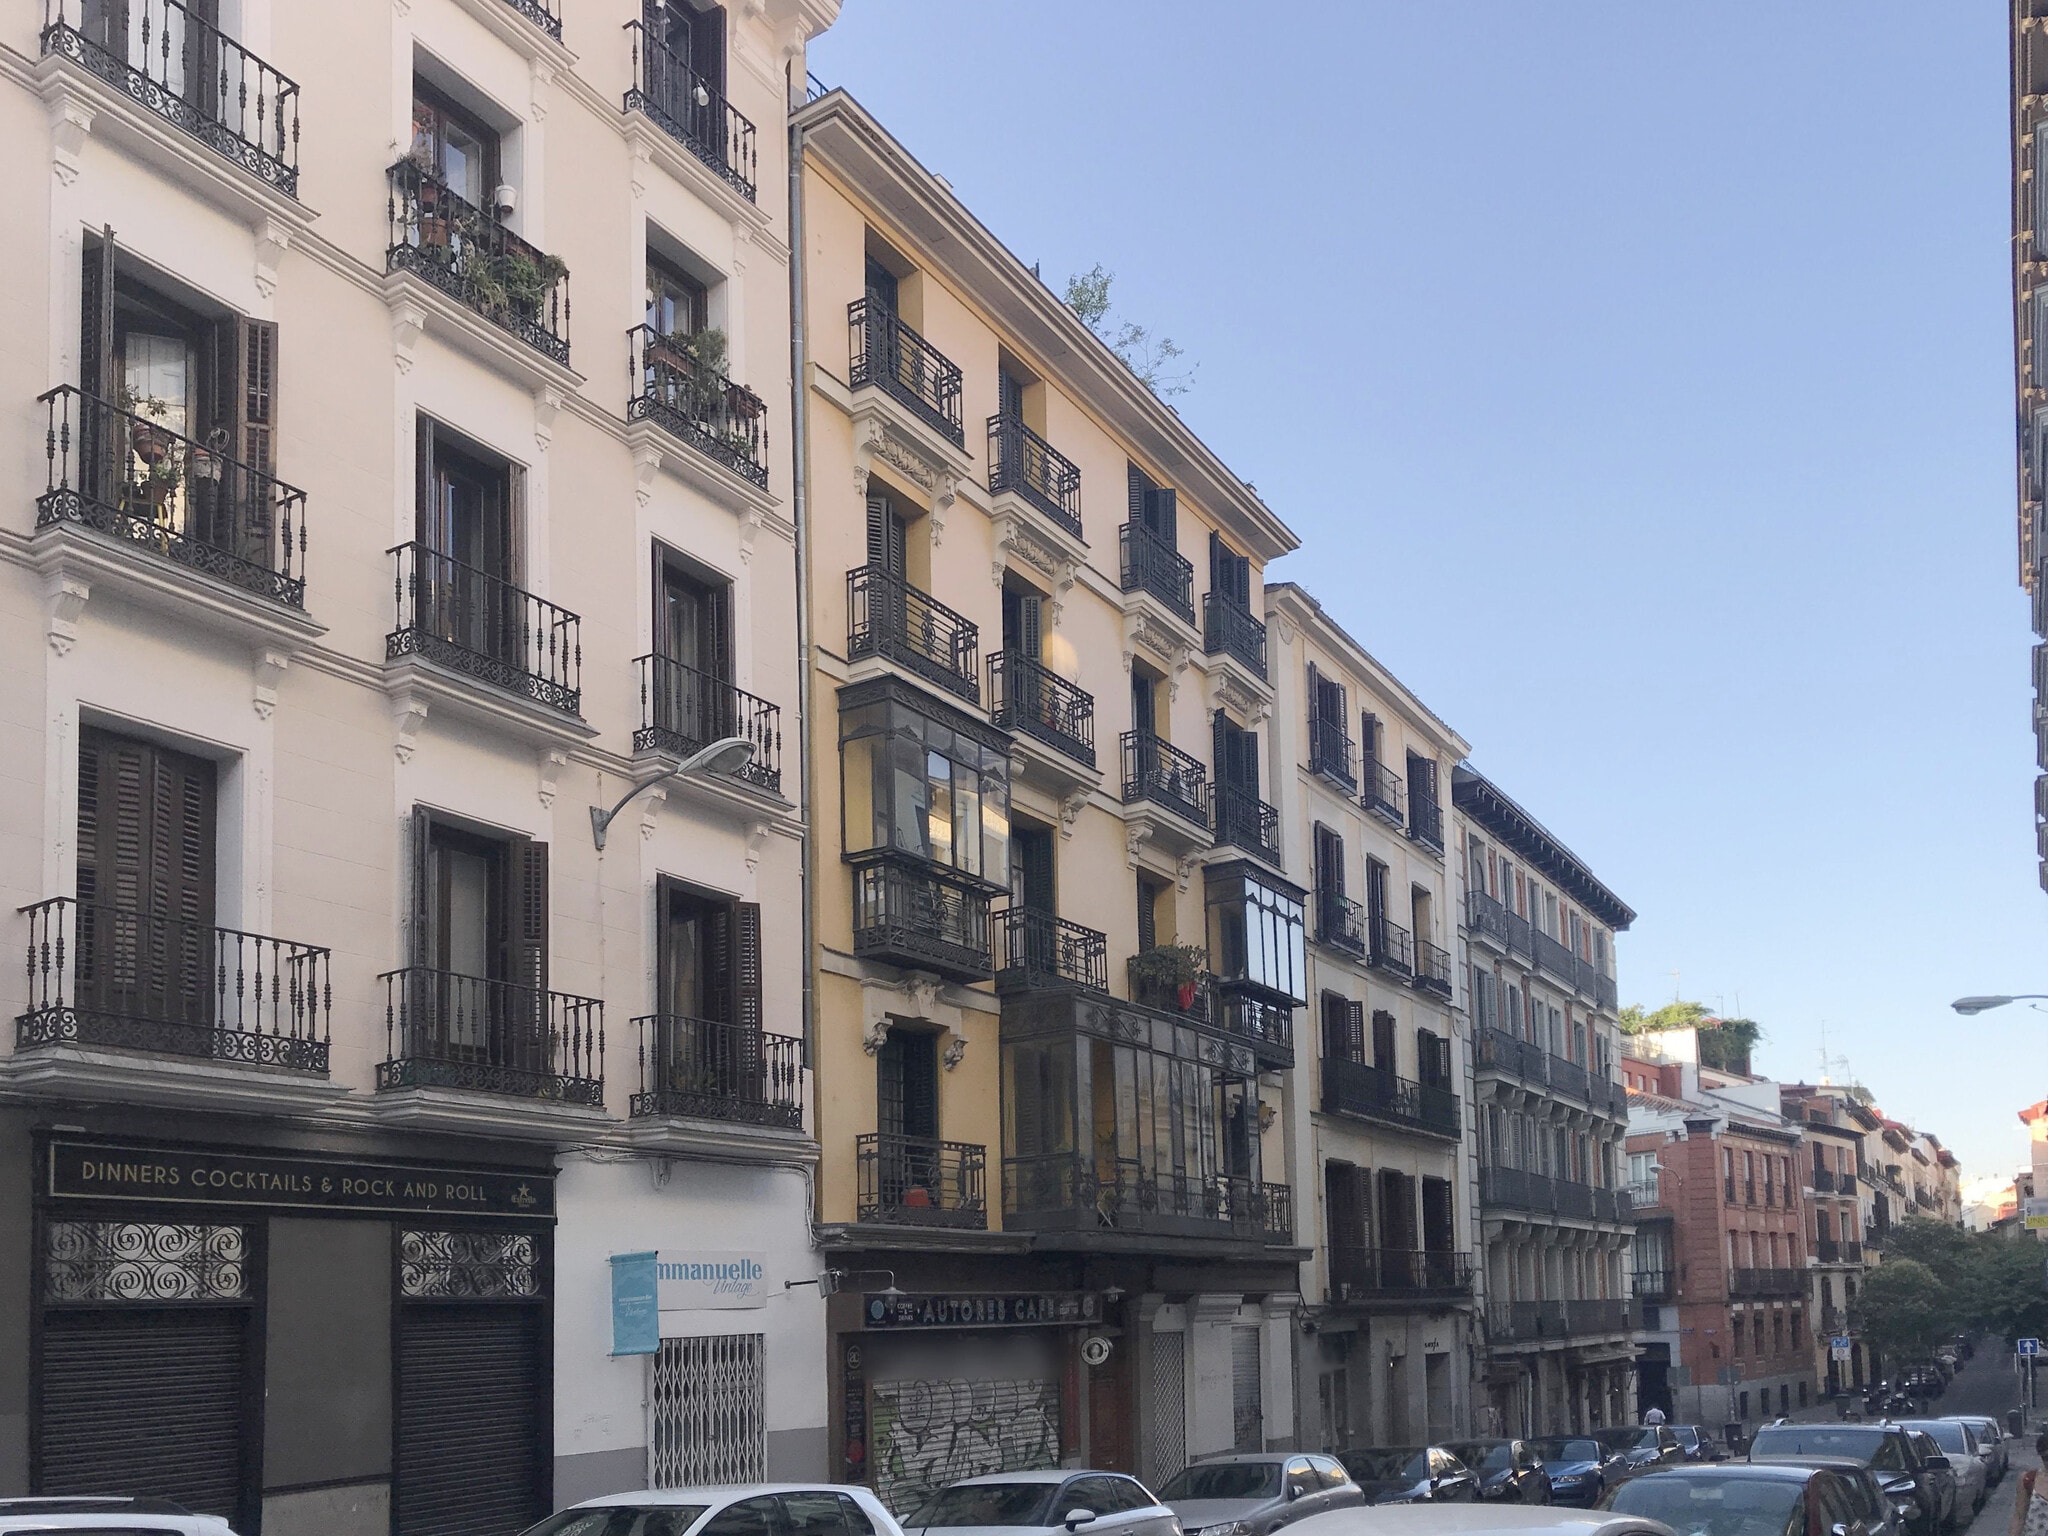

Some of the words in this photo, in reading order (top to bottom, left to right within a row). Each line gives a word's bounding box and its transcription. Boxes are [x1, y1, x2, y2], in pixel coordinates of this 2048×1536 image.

[82, 1161, 180, 1185] DINNERS
[191, 1169, 312, 1192] COCKTAILS
[321, 1177, 333, 1193] &
[343, 1178, 395, 1196] ROCK
[404, 1182, 438, 1199] AND
[446, 1184, 487, 1201] ROLL
[657, 1259, 763, 1280] mmanuelle
[703, 1274, 761, 1299] Vintage
[923, 1299, 1006, 1322] AUTORES
